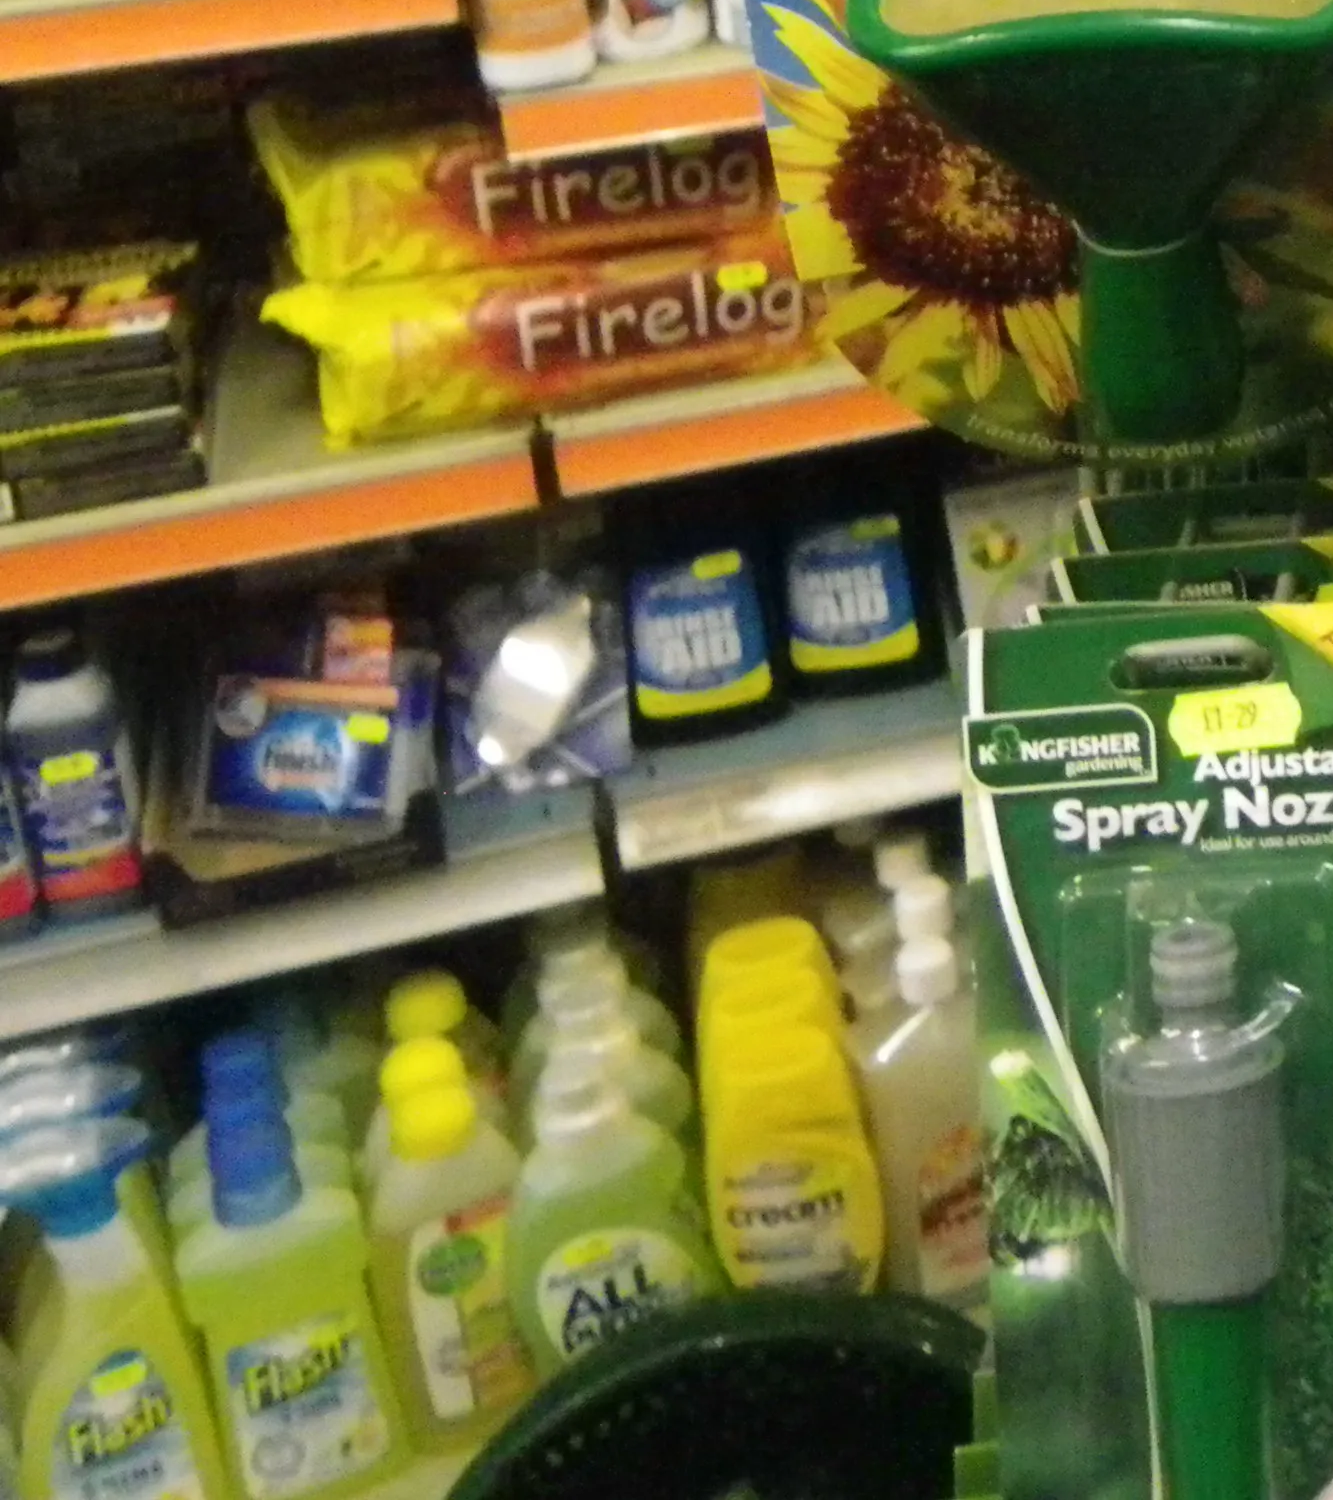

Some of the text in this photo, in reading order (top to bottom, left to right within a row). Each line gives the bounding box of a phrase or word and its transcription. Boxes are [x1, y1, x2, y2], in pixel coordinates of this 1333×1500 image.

[470, 135, 763, 240] Firelog
[515, 264, 805, 375] Firelog
[809, 588, 890, 632] AID
[660, 630, 743, 678] AID
[977, 725, 1140, 767] KINGFISHER
[1064, 755, 1143, 779] gardening
[1051, 797, 1209, 853] Spray
[562, 1259, 651, 1354] ALL
[244, 1332, 350, 1415] Flash
[67, 1392, 173, 1465] Flash
